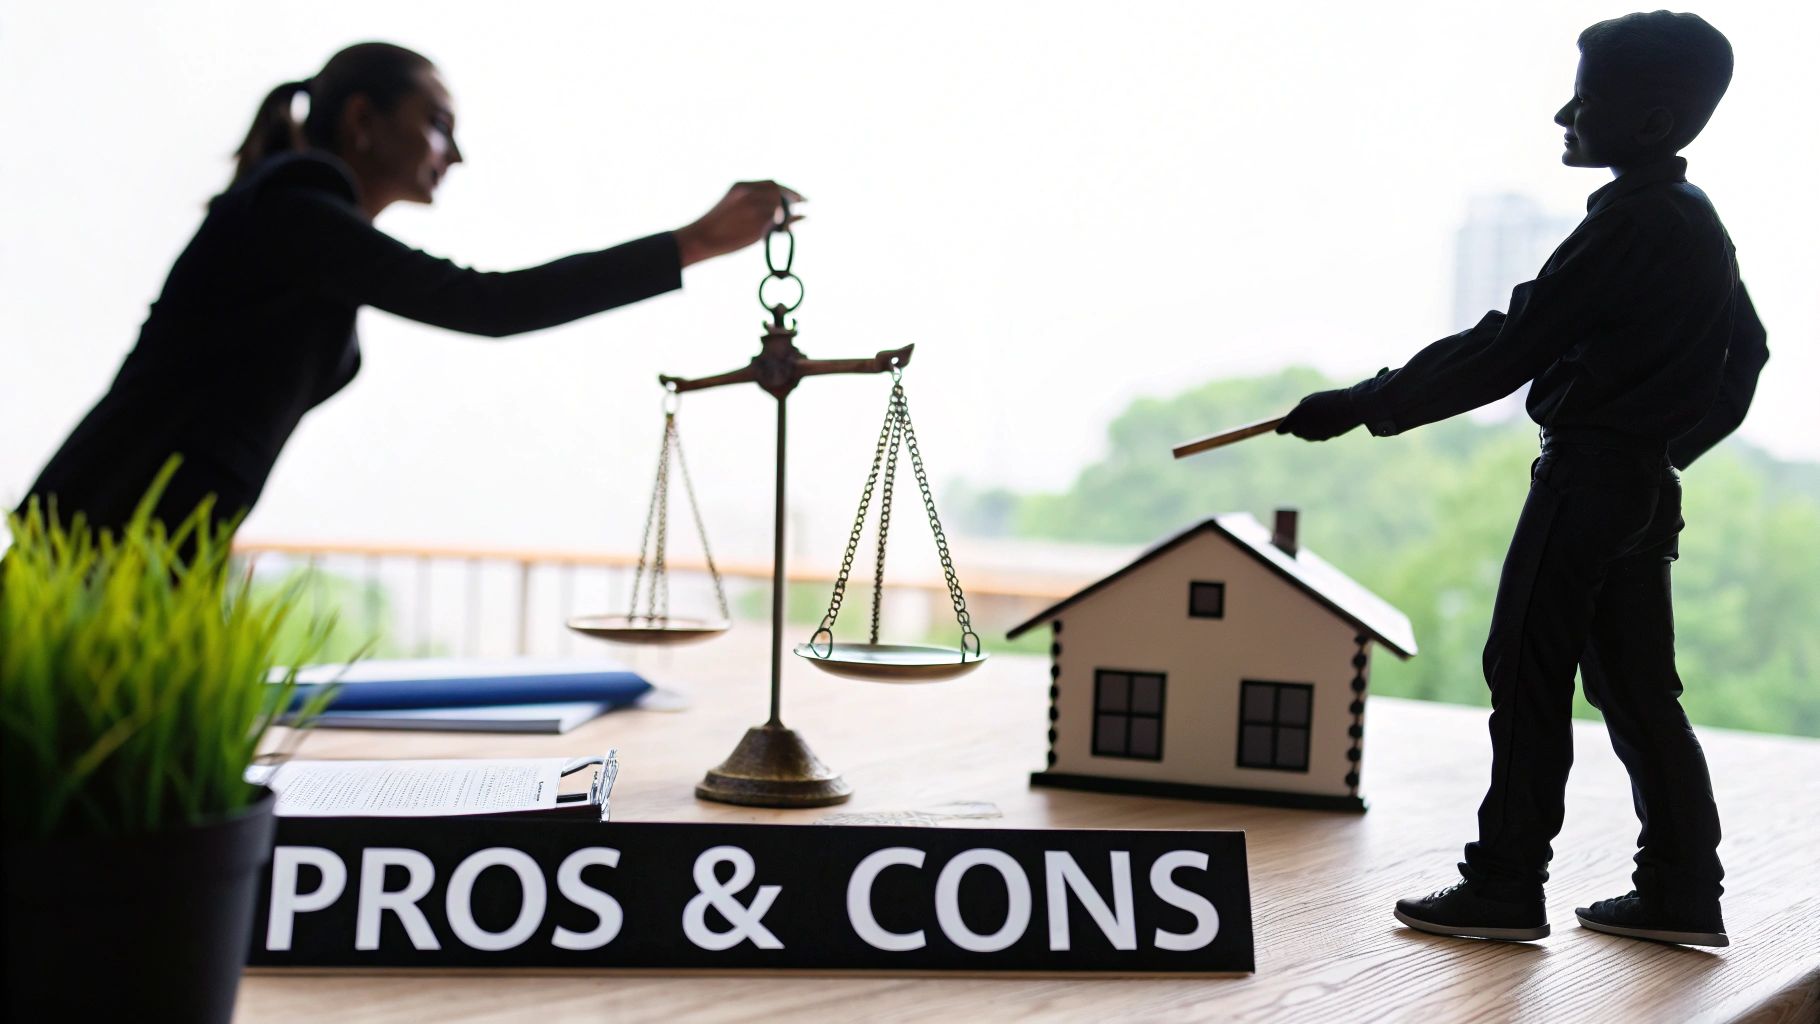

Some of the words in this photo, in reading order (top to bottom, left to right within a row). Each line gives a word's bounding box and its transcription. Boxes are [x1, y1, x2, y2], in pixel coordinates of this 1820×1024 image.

[266, 846, 623, 951] PROS
[682, 846, 784, 951] &
[847, 847, 1220, 952] CONS
